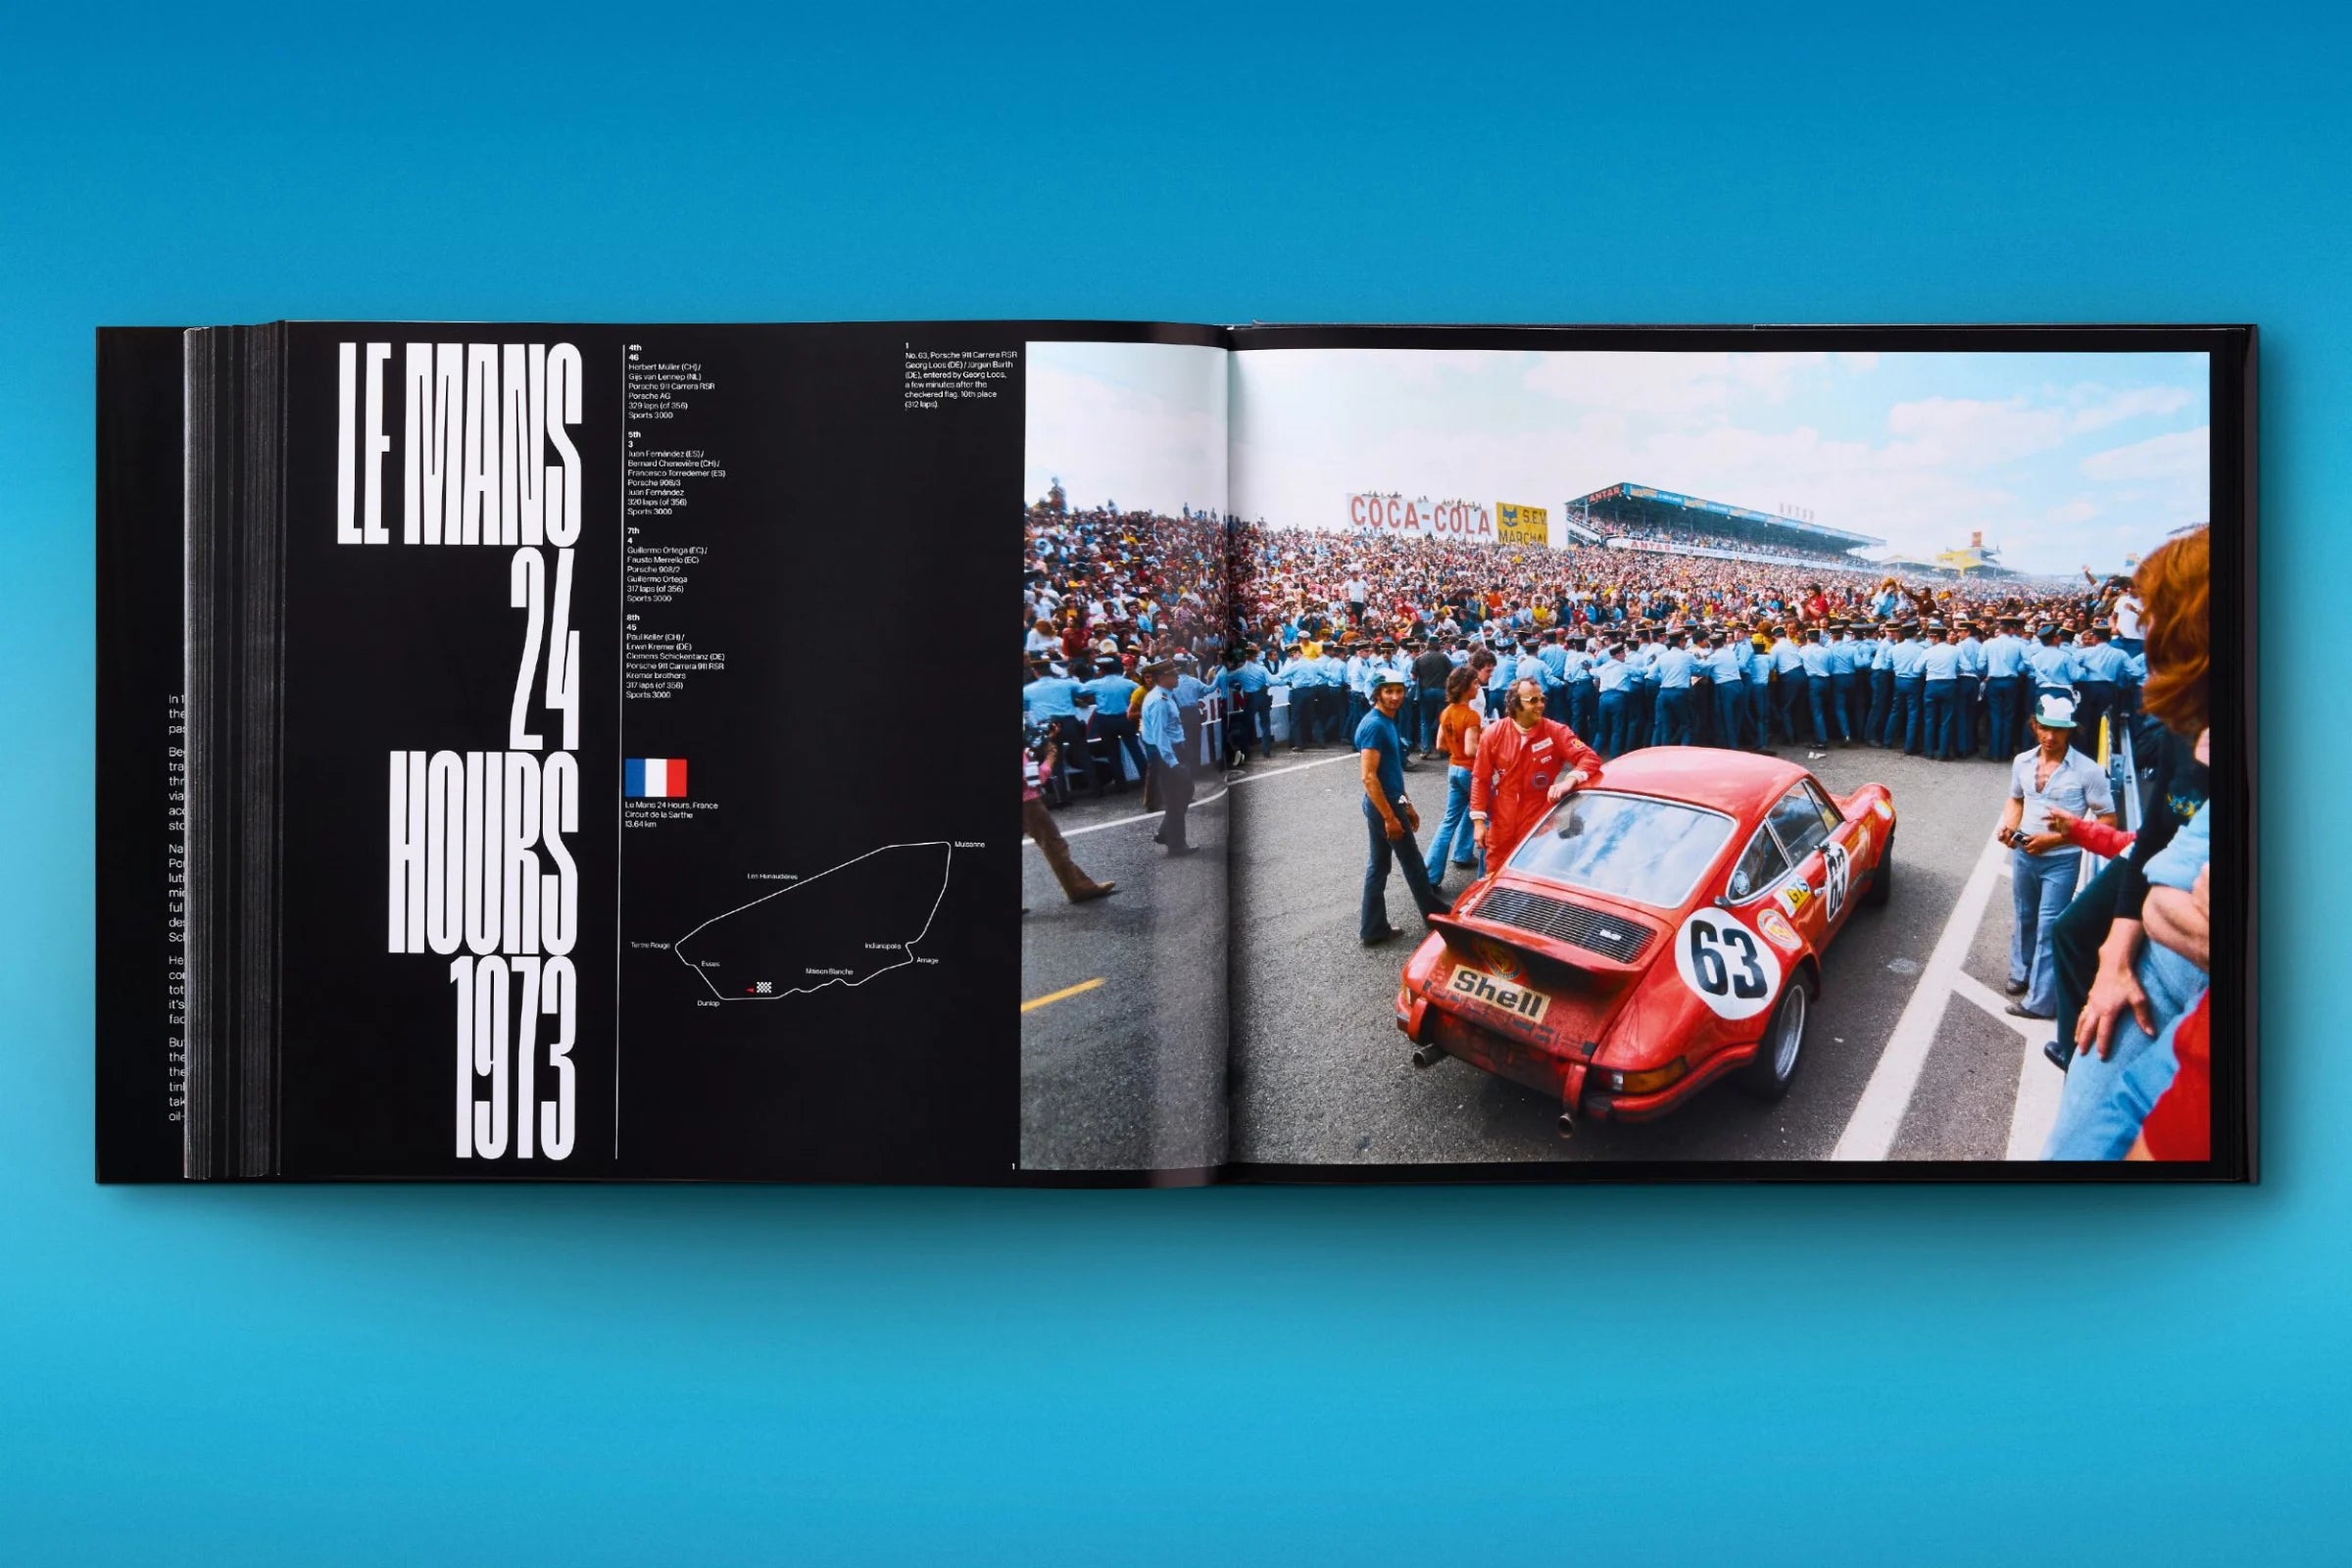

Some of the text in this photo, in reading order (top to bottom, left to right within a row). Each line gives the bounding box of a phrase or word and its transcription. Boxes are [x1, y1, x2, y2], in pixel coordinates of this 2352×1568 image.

[629, 364, 657, 372] Herbert
[906, 361, 927, 371] Georg
[928, 361, 947, 371] Loos
[948, 361, 962, 371] (DE)
[993, 361, 1013, 371] Barth
[644, 402, 659, 411] laps
[338, 343, 582, 548] LE MANS
[628, 460, 658, 468] Bernard
[1589, 486, 1620, 503] ANTAR
[627, 508, 652, 516] Sports
[1351, 495, 1492, 536] COCA-COLA
[662, 547, 688, 556] Ortega
[510, 546, 579, 750] 24
[389, 752, 578, 955] HOURS
[651, 941, 670, 950] Rouge
[1690, 919, 1768, 1000] 63
[1454, 969, 1545, 1018] Shell
[451, 955, 576, 1160] 1973
